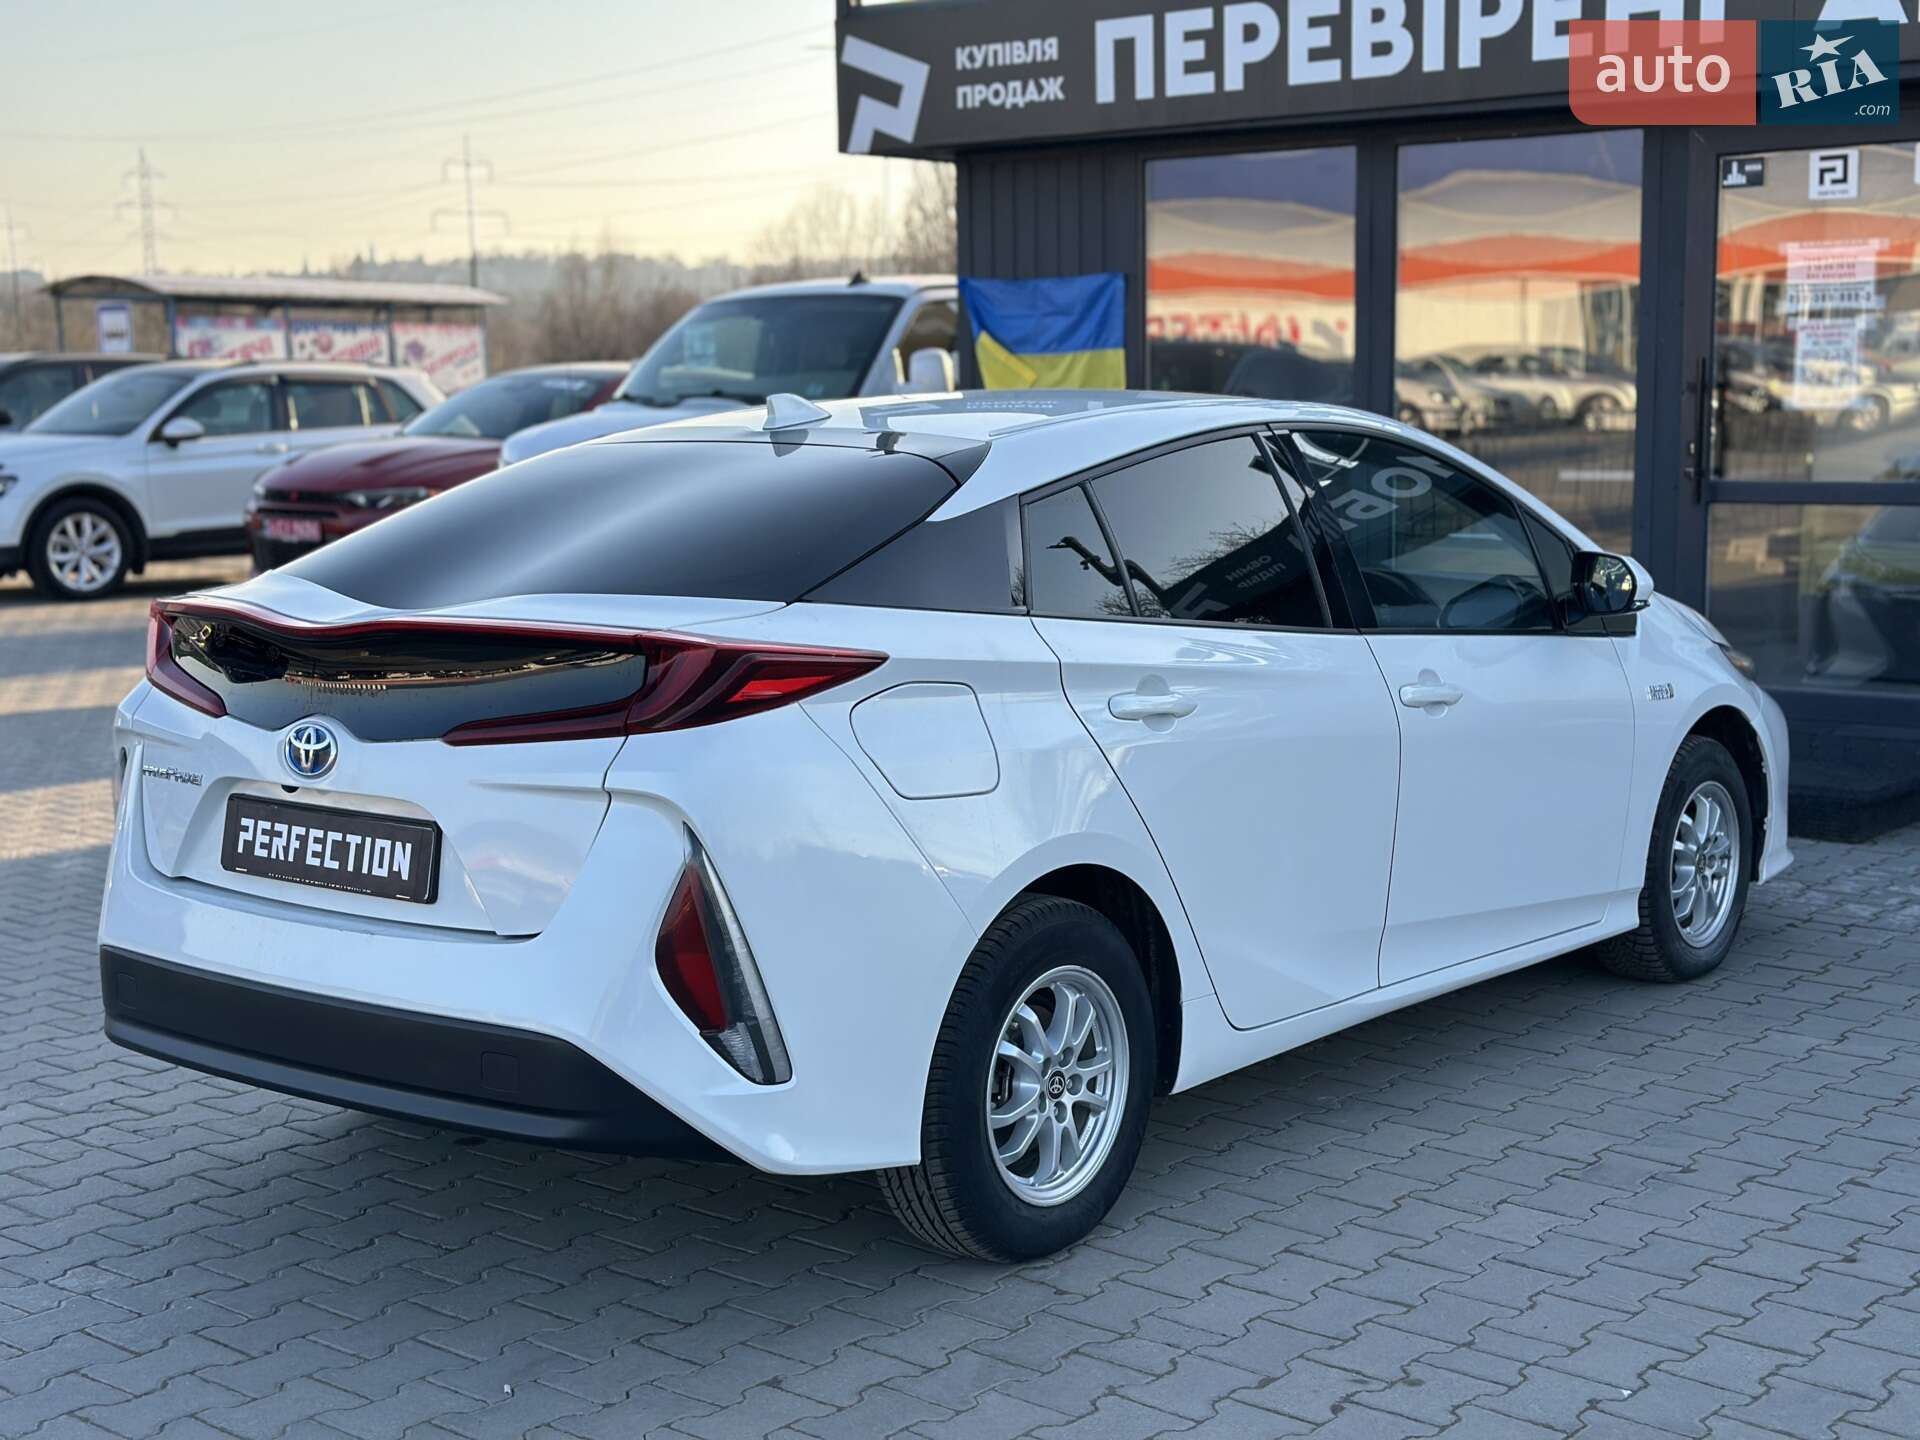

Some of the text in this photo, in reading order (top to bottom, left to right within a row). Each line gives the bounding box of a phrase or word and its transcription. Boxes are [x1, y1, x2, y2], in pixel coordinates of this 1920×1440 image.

[955, 37, 1059, 70] КУПІВЛЯ
[956, 76, 1065, 109] ПРОДАЖ
[237, 818, 412, 880] PERFECTION
